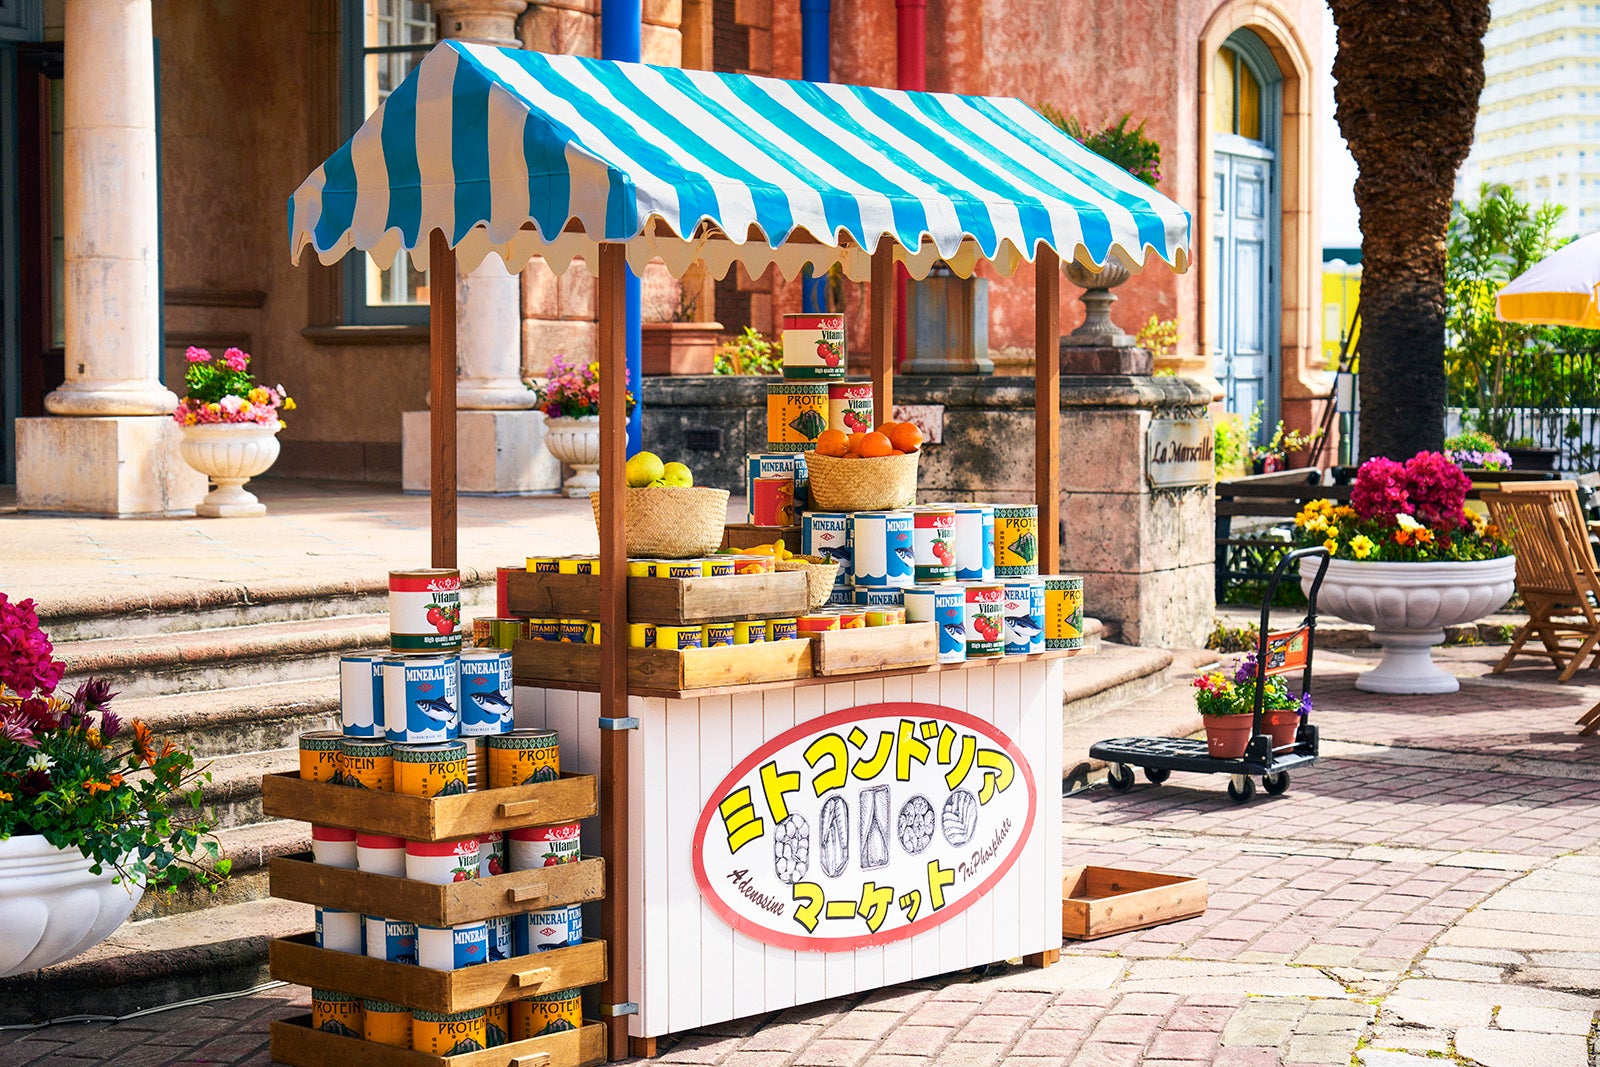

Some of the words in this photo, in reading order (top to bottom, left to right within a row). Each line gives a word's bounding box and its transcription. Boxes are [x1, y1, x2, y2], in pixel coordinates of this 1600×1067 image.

[761, 461, 794, 472] MINERAL
[812, 520, 846, 531] MINERAL
[1004, 589, 1029, 601] NERAL
[406, 668, 445, 681] MINERAL
[461, 662, 499, 675] MINERAL
[719, 719, 1015, 855] ミトコンドリア
[726, 869, 785, 916] Adenosine
[792, 859, 955, 933] マーケット
[529, 912, 567, 925] MINERAL
[531, 998, 580, 1014] PROTEIN
